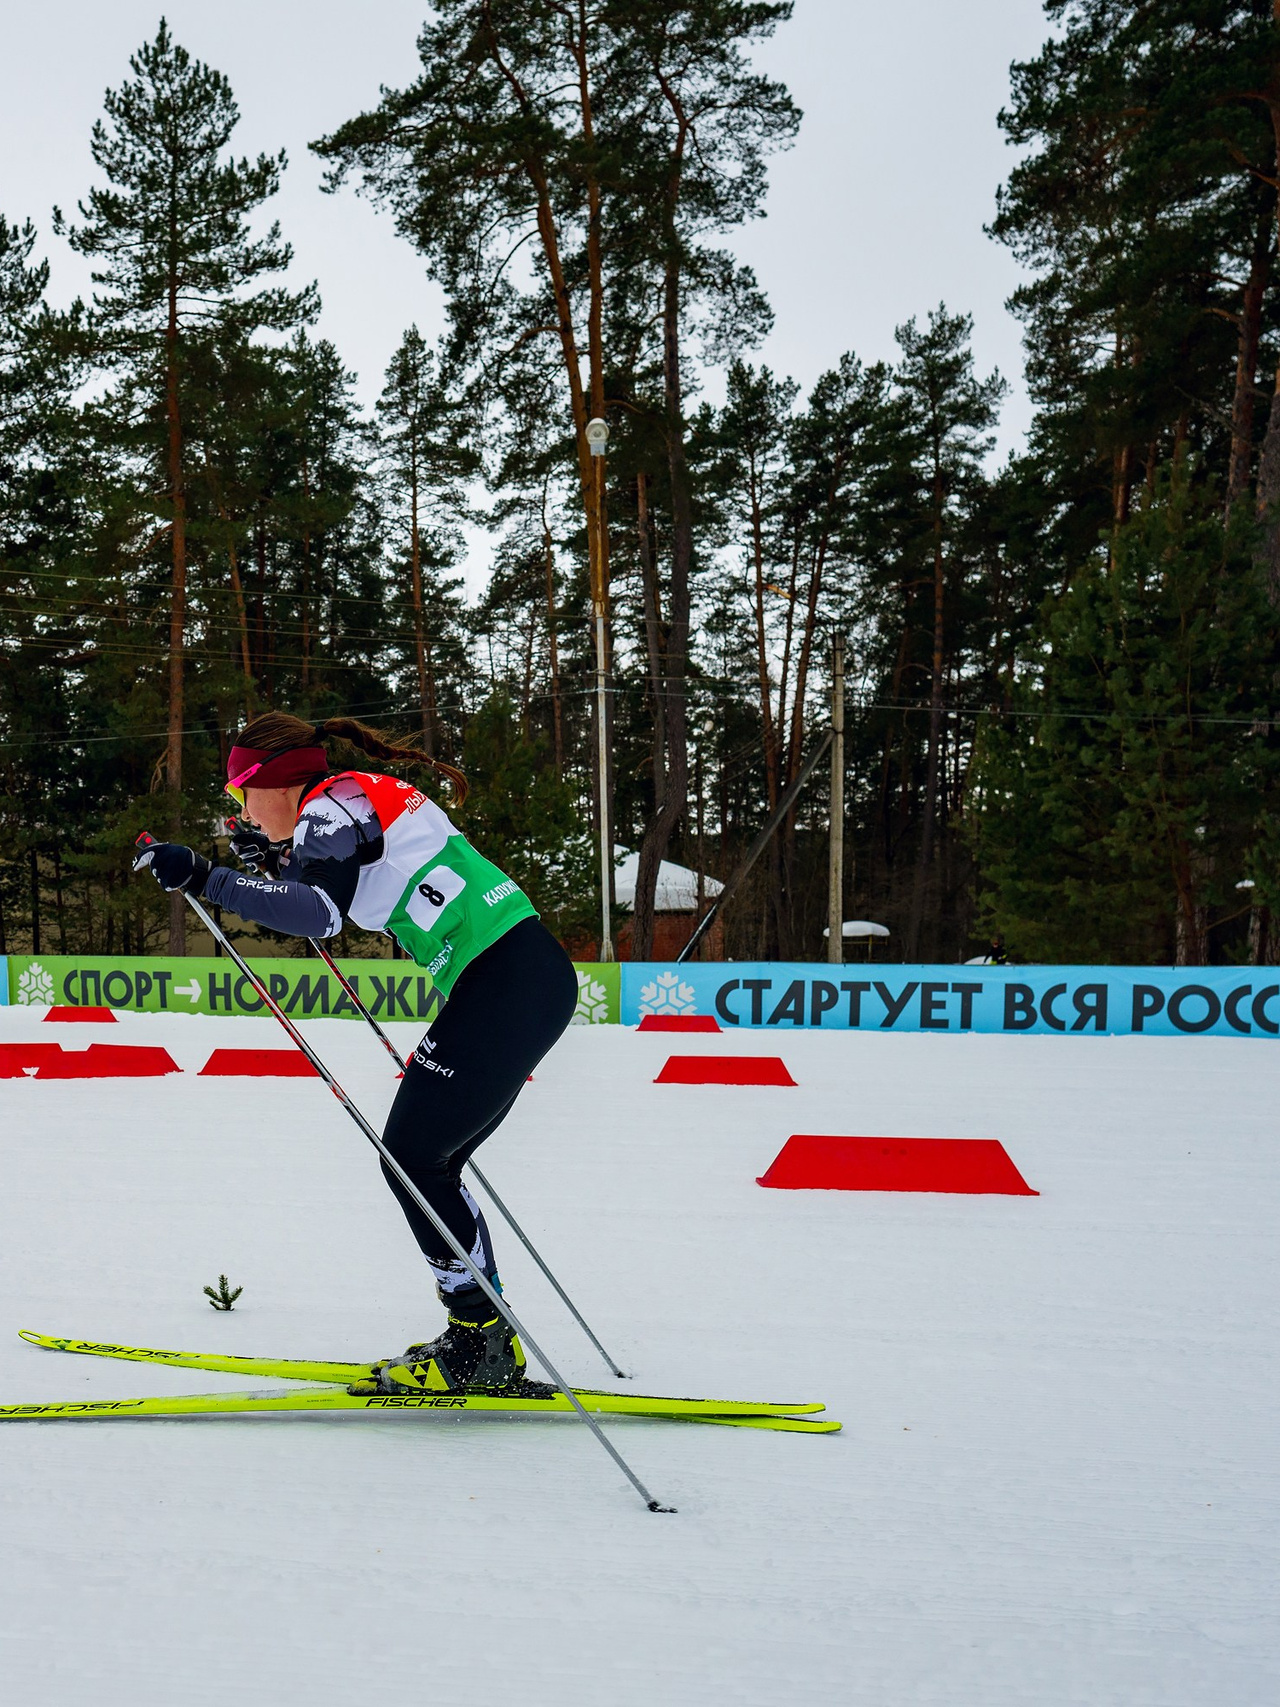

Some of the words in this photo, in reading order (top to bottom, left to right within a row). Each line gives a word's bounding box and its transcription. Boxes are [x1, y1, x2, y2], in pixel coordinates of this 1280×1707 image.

[419, 883, 445, 907] 8
[482, 879, 521, 907] КАЛУЖ
[63, 969, 172, 1008] СПОРТ
[368, 975, 447, 1018] ЖИ
[715, 978, 983, 1029] СТАРТУЕТ
[1003, 982, 1108, 1031] ВСЯ
[1131, 984, 1280, 1034] РОСС
[365, 1397, 468, 1408] FISCHER
